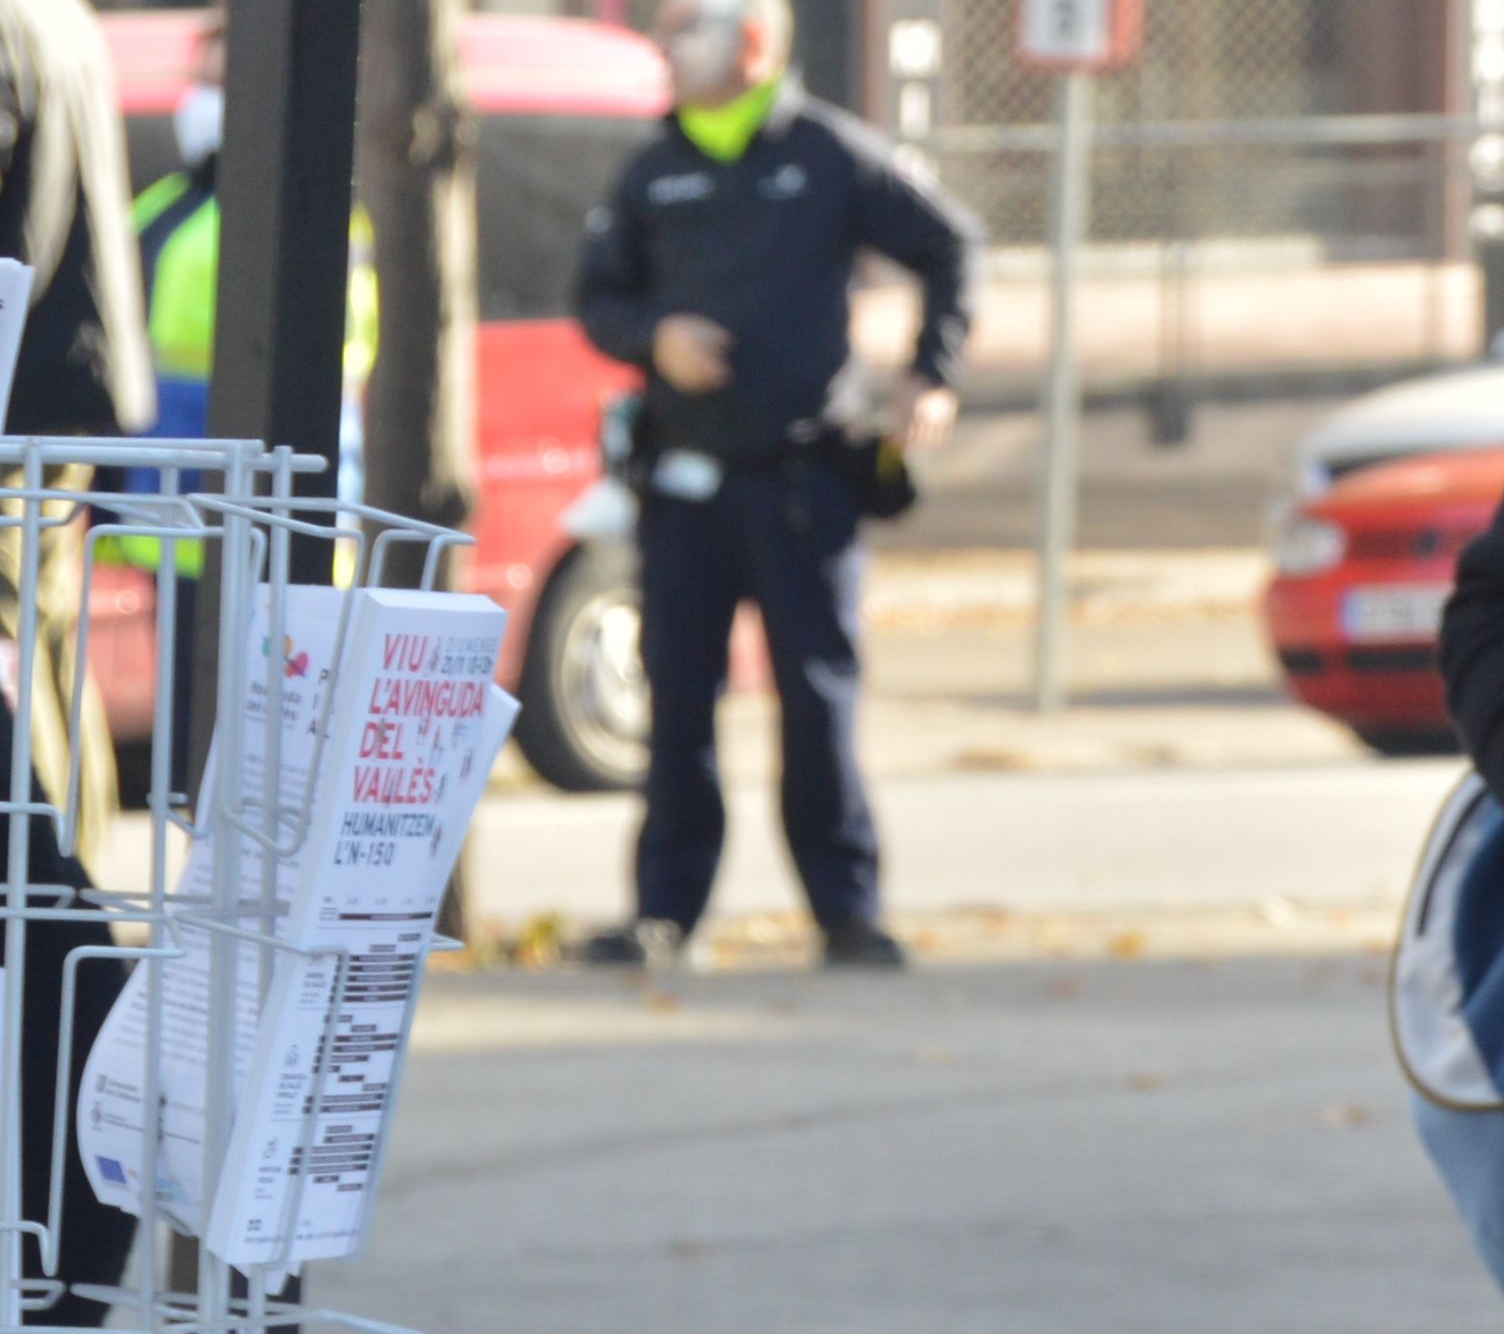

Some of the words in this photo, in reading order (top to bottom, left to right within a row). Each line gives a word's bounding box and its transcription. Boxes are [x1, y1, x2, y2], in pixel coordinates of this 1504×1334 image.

[383, 633, 429, 674] VIU
[368, 676, 487, 719] L'AVINGUDA
[358, 721, 405, 761] DEL
[353, 756, 436, 805] VALLÈS
[339, 812, 436, 838] HUMANITZEM
